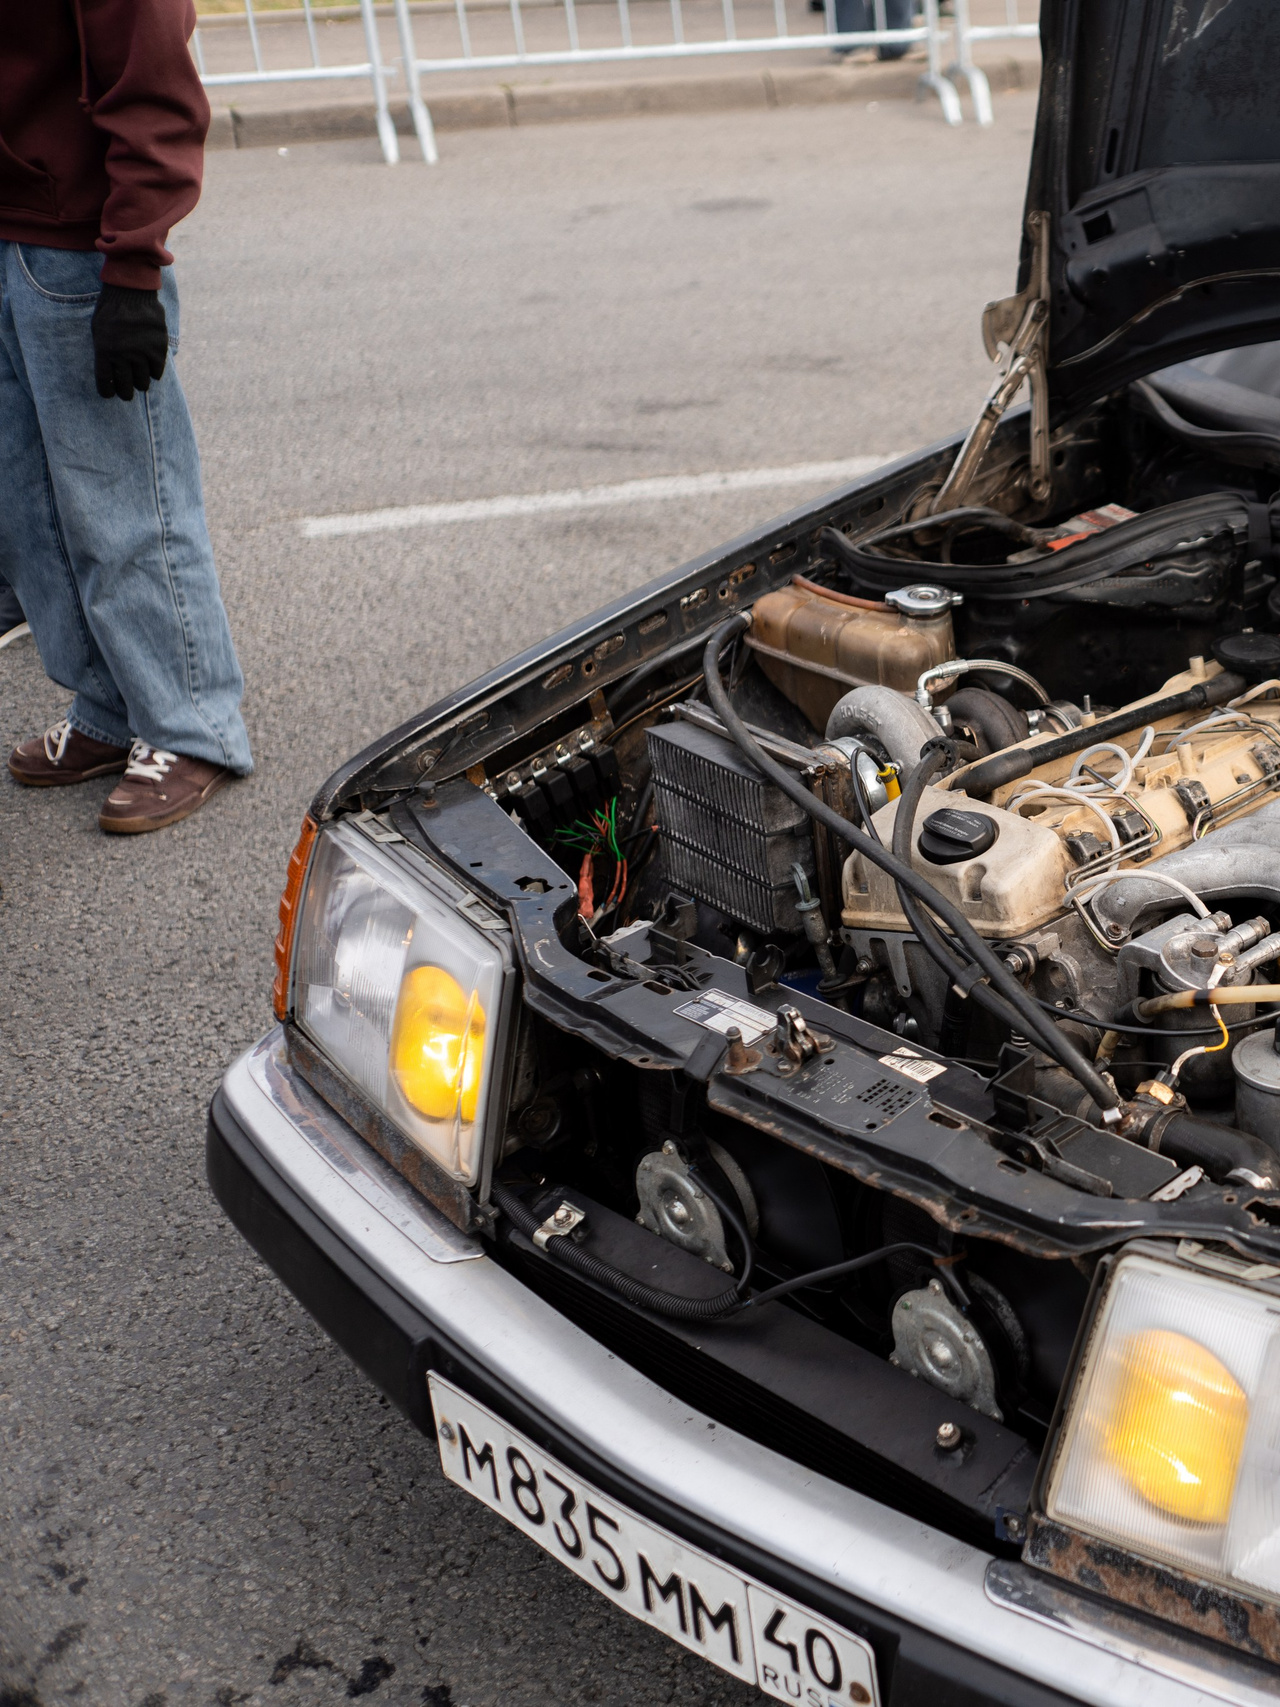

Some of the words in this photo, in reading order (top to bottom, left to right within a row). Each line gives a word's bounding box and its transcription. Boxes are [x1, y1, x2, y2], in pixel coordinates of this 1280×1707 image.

[840, 704, 881, 731] HOLSET
[763, 1608, 842, 1691] 40
[762, 1664, 824, 1707] RUS
